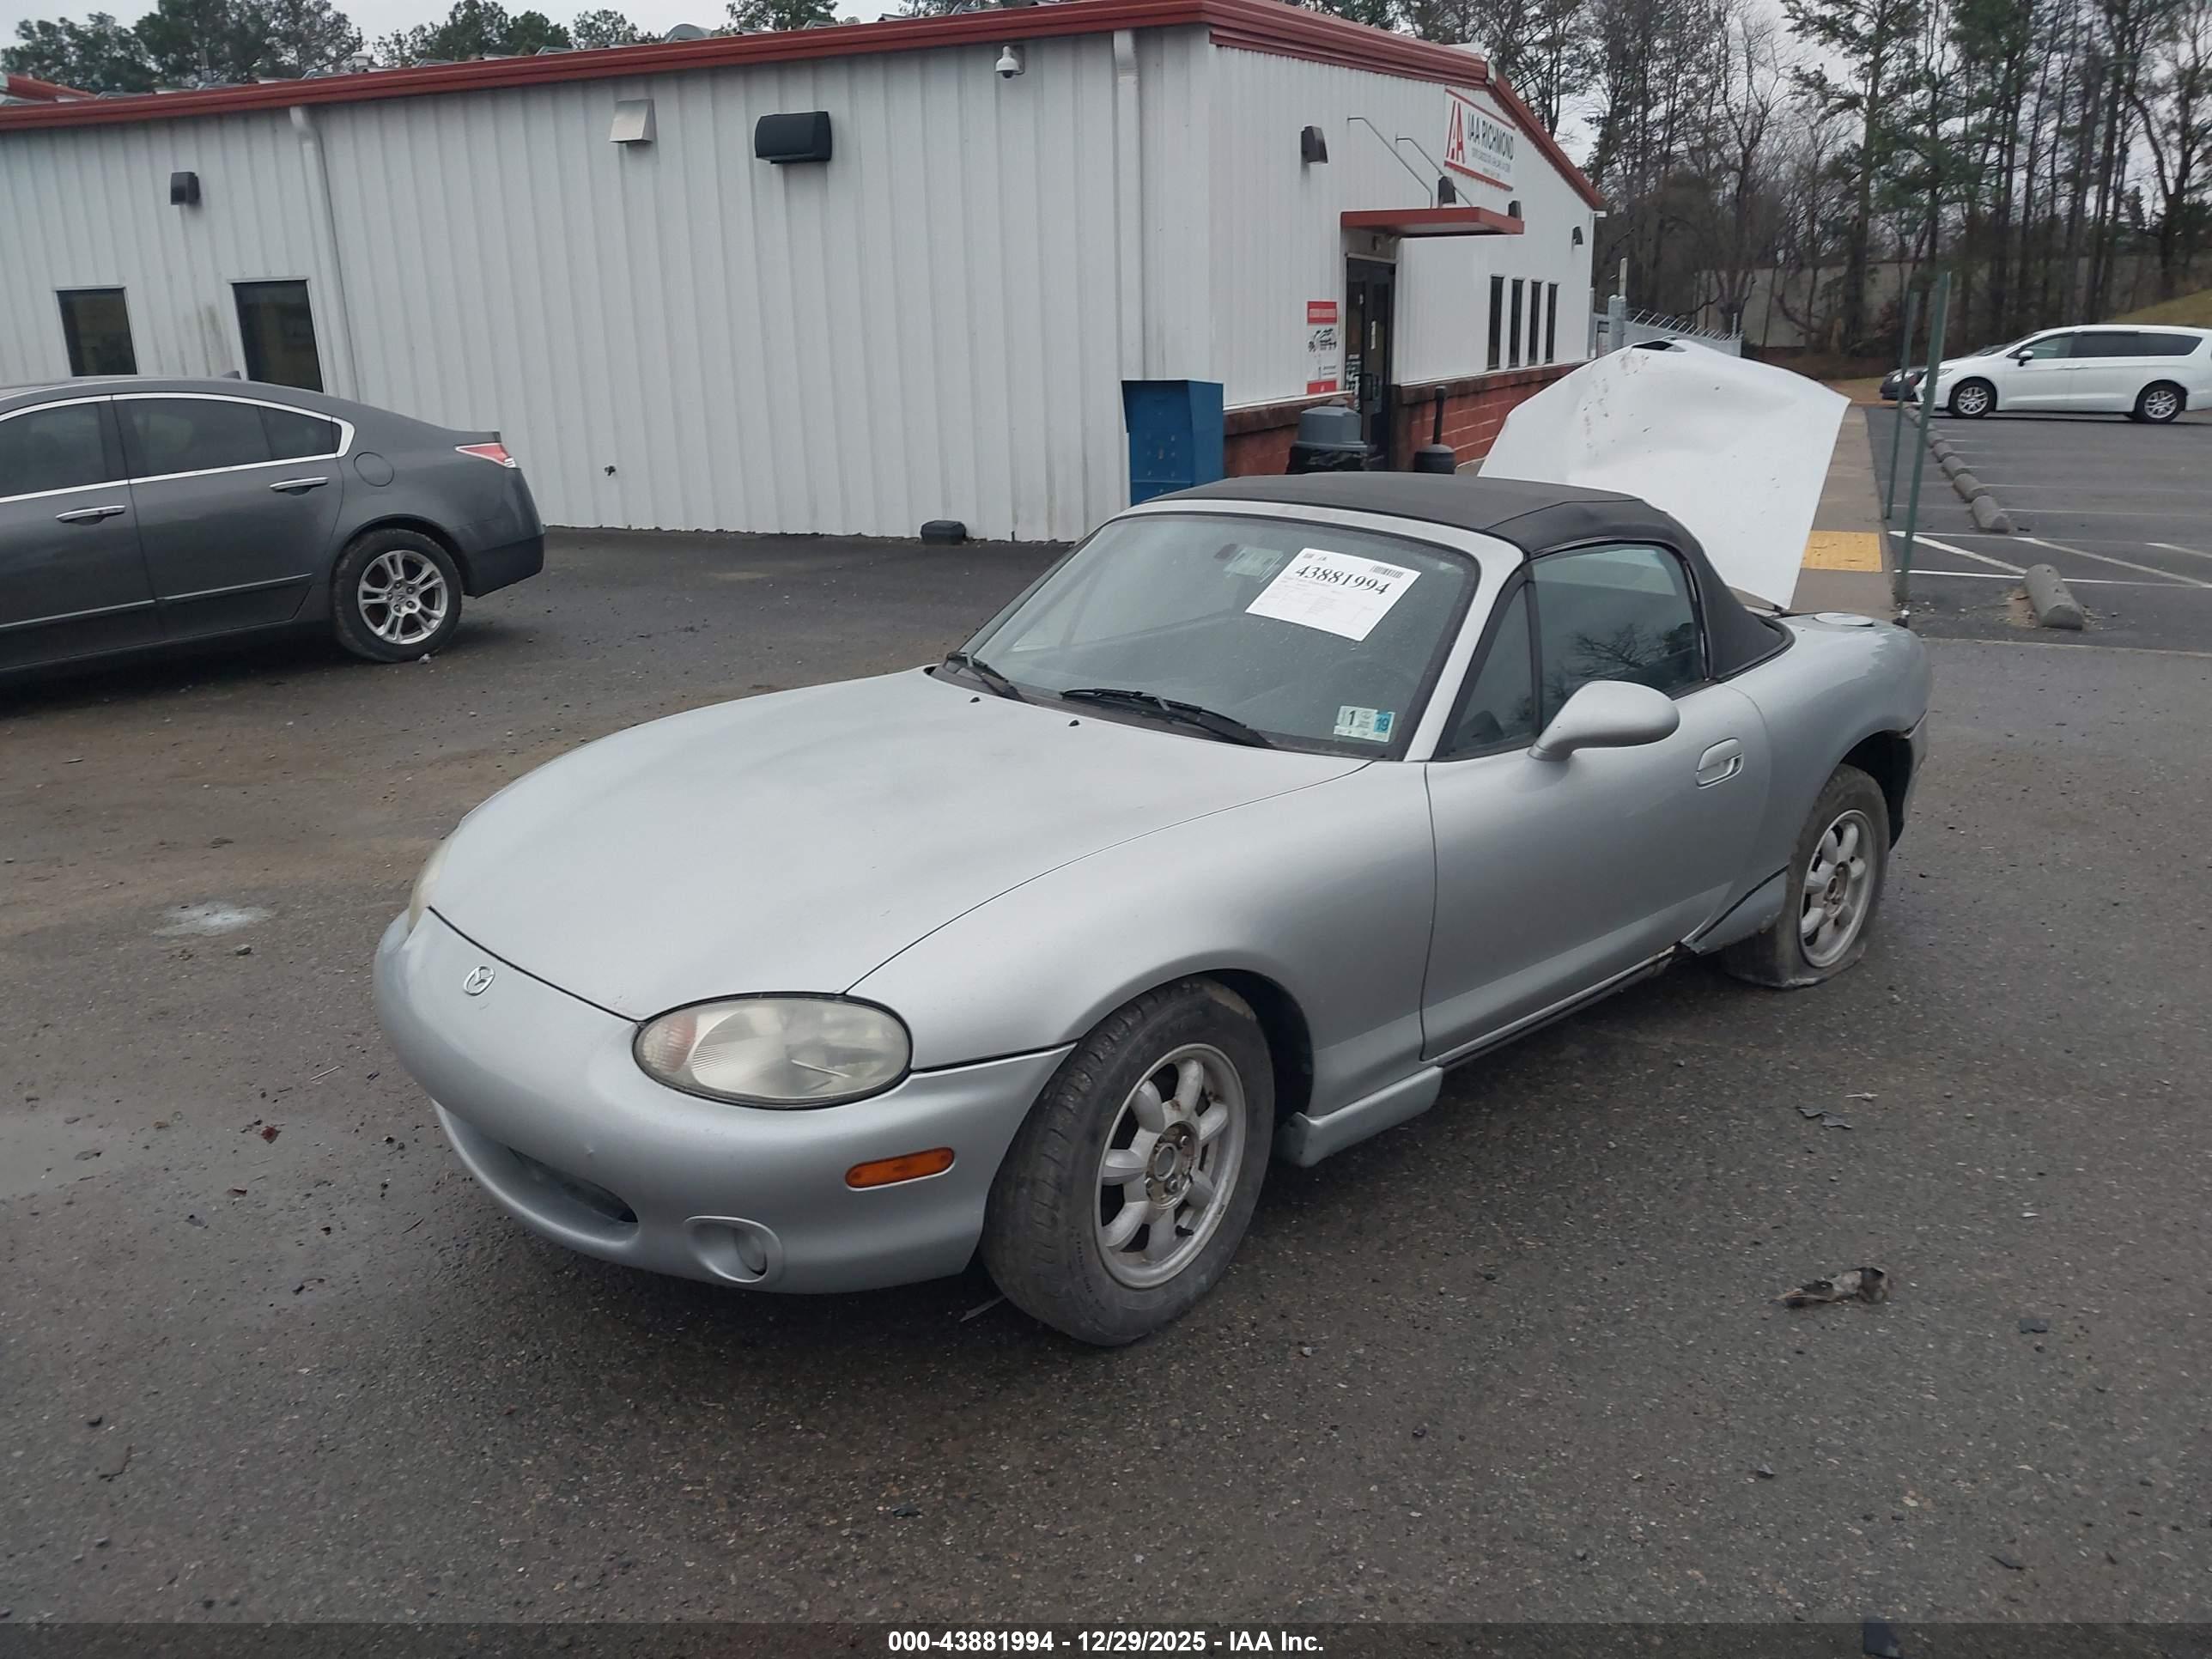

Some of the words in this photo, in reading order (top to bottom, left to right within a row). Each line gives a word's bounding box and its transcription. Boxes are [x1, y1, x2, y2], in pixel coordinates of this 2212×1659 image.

[1468, 112, 1481, 145] IAA
[1481, 120, 1514, 161] RICHMOND
[1296, 565, 1391, 595] 43881994
[1348, 709, 1356, 726] 1
